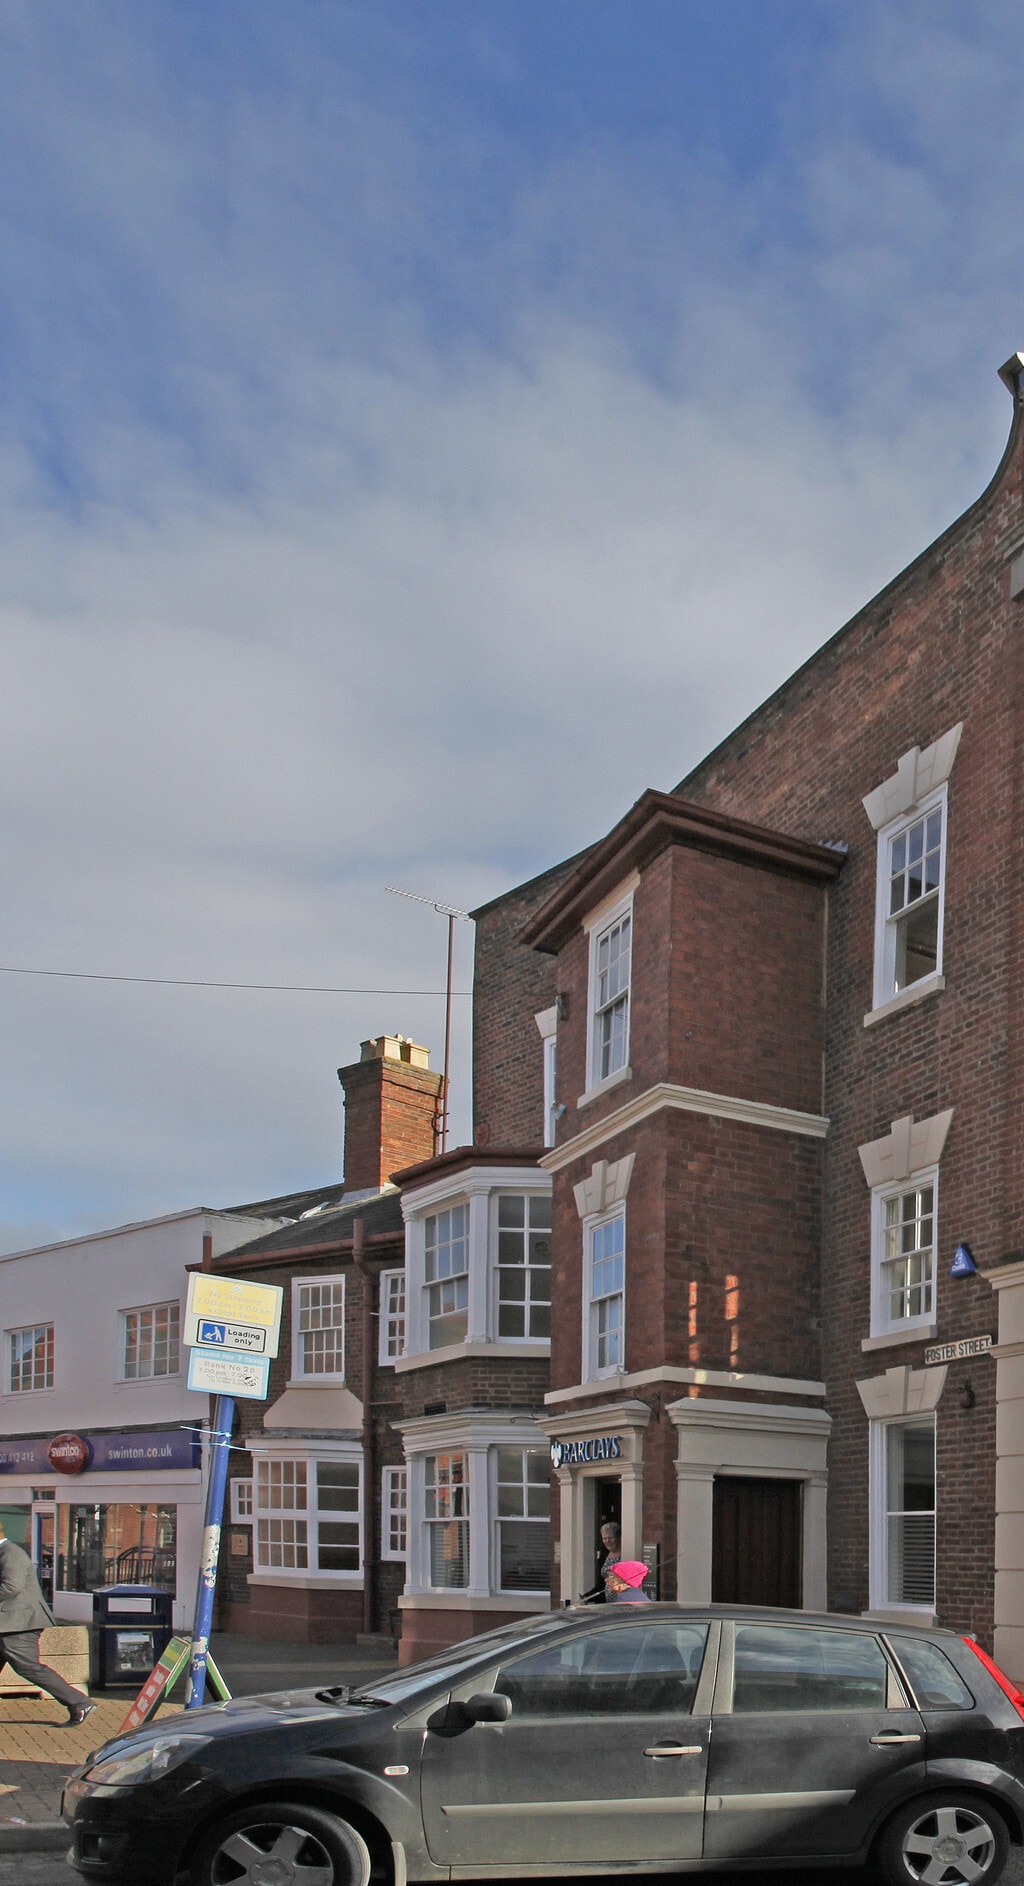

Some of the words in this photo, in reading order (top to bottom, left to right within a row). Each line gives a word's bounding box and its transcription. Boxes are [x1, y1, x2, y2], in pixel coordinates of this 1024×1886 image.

[228, 1329, 261, 1340] Loading
[234, 1337, 253, 1346] only
[926, 1345, 957, 1362] FOSTER
[958, 1337, 990, 1357] STREET
[204, 1360, 226, 1369] Rank
[51, 1445, 80, 1458] swinton
[108, 1444, 173, 1460] swinton.co.uk
[562, 1435, 621, 1463] BARCLAYS
